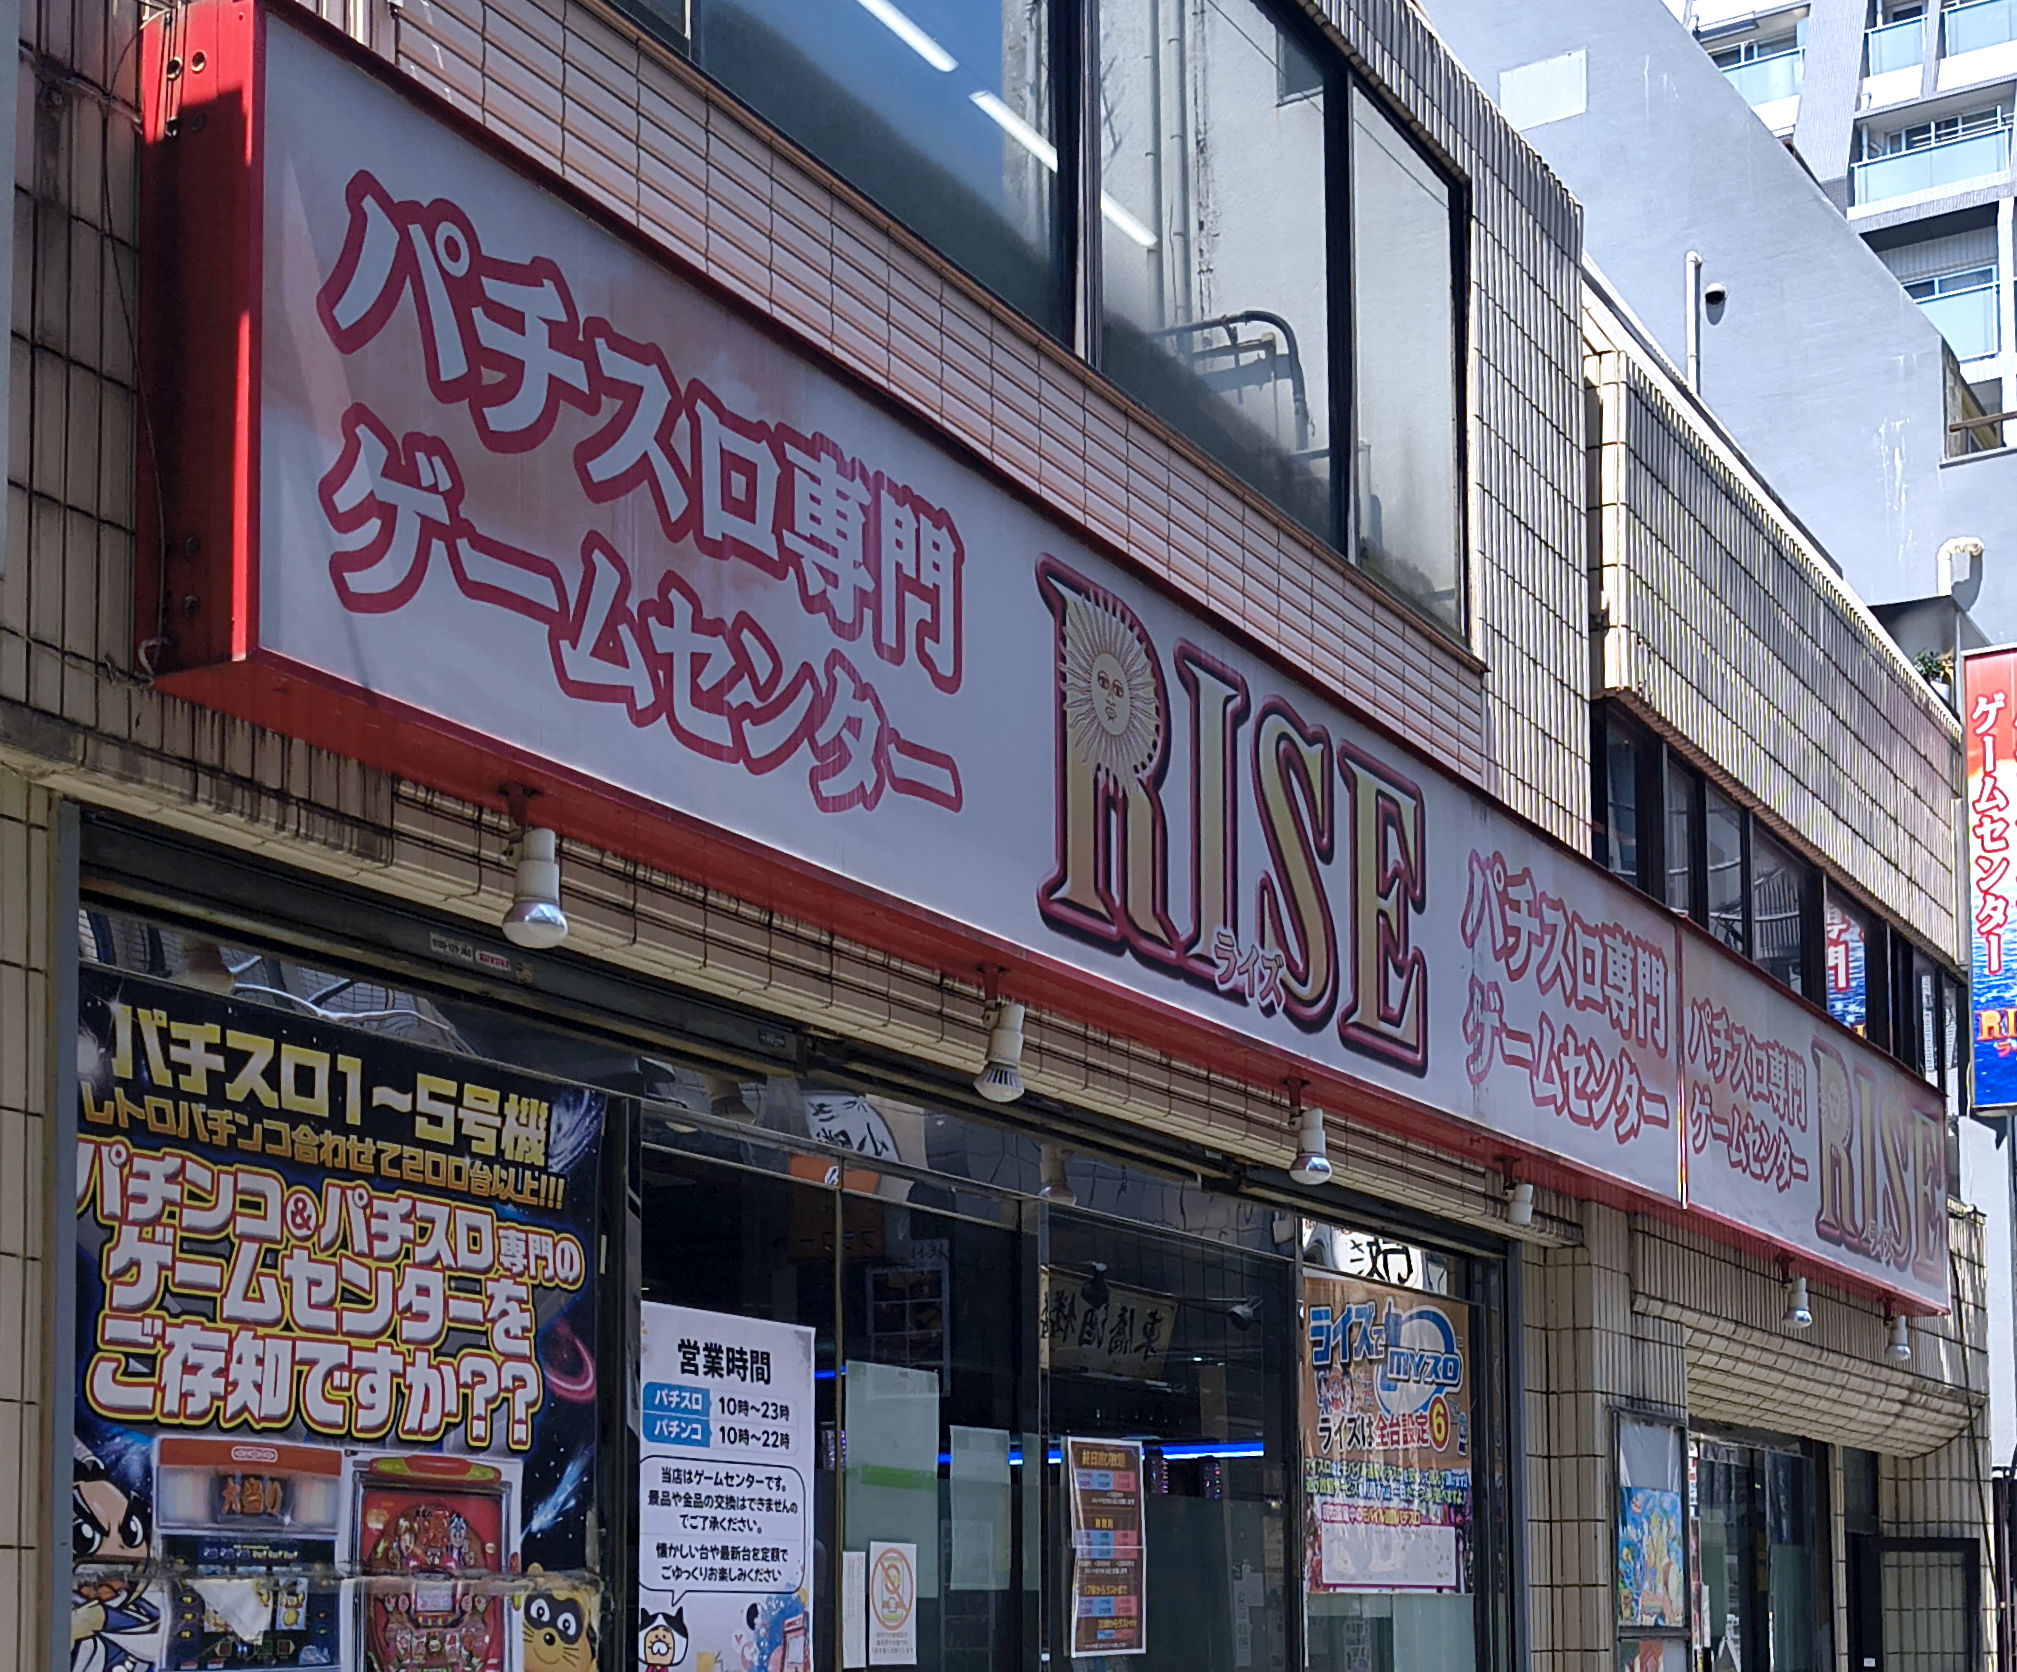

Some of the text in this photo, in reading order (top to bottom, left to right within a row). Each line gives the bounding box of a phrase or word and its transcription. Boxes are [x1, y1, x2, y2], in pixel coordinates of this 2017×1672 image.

[316, 169, 963, 694] パチスロ専門
[319, 403, 963, 812] ゲームセンター
[1035, 553, 1427, 1077] RISE
[1971, 692, 2010, 976] ゲームセンター
[1214, 928, 1285, 1011] ライズ
[1461, 849, 1668, 1058] パチスロ専門
[1463, 977, 1668, 1144] ゲームセンター
[1688, 997, 1807, 1132] パチスロ専門
[1690, 1080, 1808, 1192] ゲームセンター
[1811, 1034, 1946, 1288] RISE
[104, 1222, 535, 1359] ゲームセンターを
[678, 1339, 771, 1385] 営業時間
[1309, 1302, 1386, 1367] ライズで
[654, 1389, 703, 1411] パチスロ
[654, 1418, 703, 1440] パチンコ
[221, 1476, 283, 1516] 大当り
[647, 1490, 798, 1514] 景品や金品の交換はできませんの
[661, 1466, 786, 1492] 当店はゲームセンターです。
[655, 1541, 788, 1563] 懐かしい台や最新台を定額で
[679, 1514, 763, 1534] でご了承ください。
[661, 1564, 782, 1584] ごゆっくりお楽しみください
